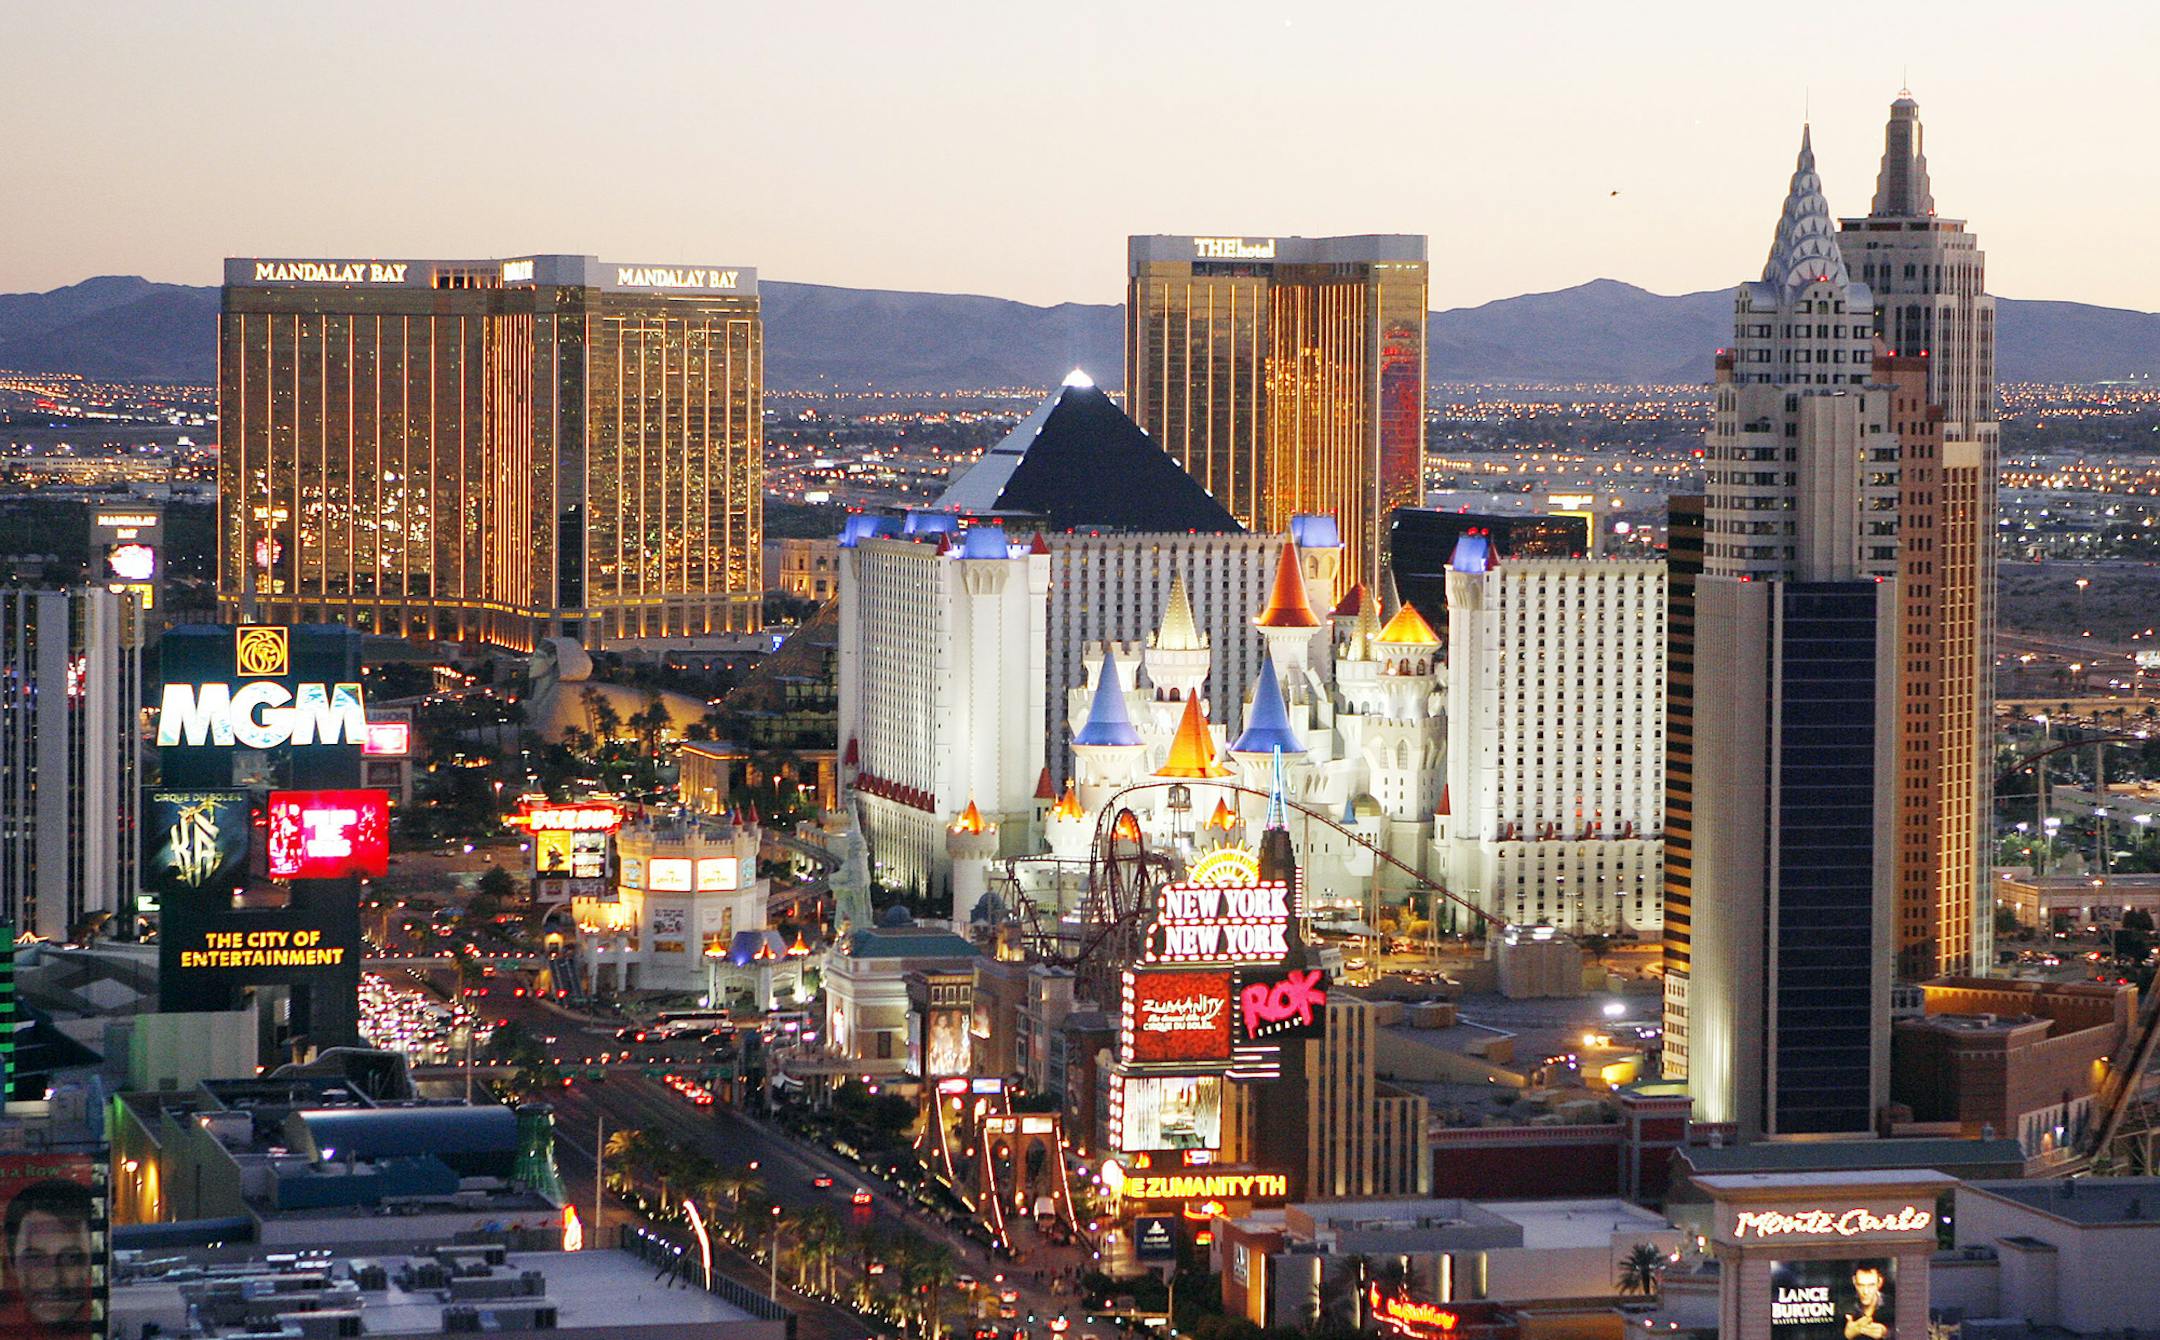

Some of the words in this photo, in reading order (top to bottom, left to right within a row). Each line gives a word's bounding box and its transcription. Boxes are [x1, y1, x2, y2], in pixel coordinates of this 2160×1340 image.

[1194, 238, 1275, 258] THEhotel
[255, 262, 365, 282] MANDALAY
[370, 263, 408, 283] BAY
[617, 267, 706, 287] MANDALAY
[709, 271, 739, 288] BAY
[156, 681, 367, 749] MGM
[1165, 889, 1221, 919] NEW
[1223, 888, 1289, 918] YORK
[205, 932, 243, 949] THE
[247, 931, 289, 948] CITY
[293, 930, 321, 947] OF
[1164, 925, 1220, 955] NEW
[1223, 924, 1289, 954] YORK
[181, 948, 344, 967] ENTERTAINMENT
[1142, 993, 1224, 1020] ZUMANITY
[1240, 969, 1327, 1039] ROK
[1146, 1175, 1254, 1198] ZUMANITY
[1255, 1175, 1286, 1196] TH
[1734, 1209, 1835, 1238] Monte
[1833, 1204, 1932, 1236] Carlo
[1778, 1287, 1829, 1302] LANCE
[1772, 1302, 1835, 1318] BURTON
